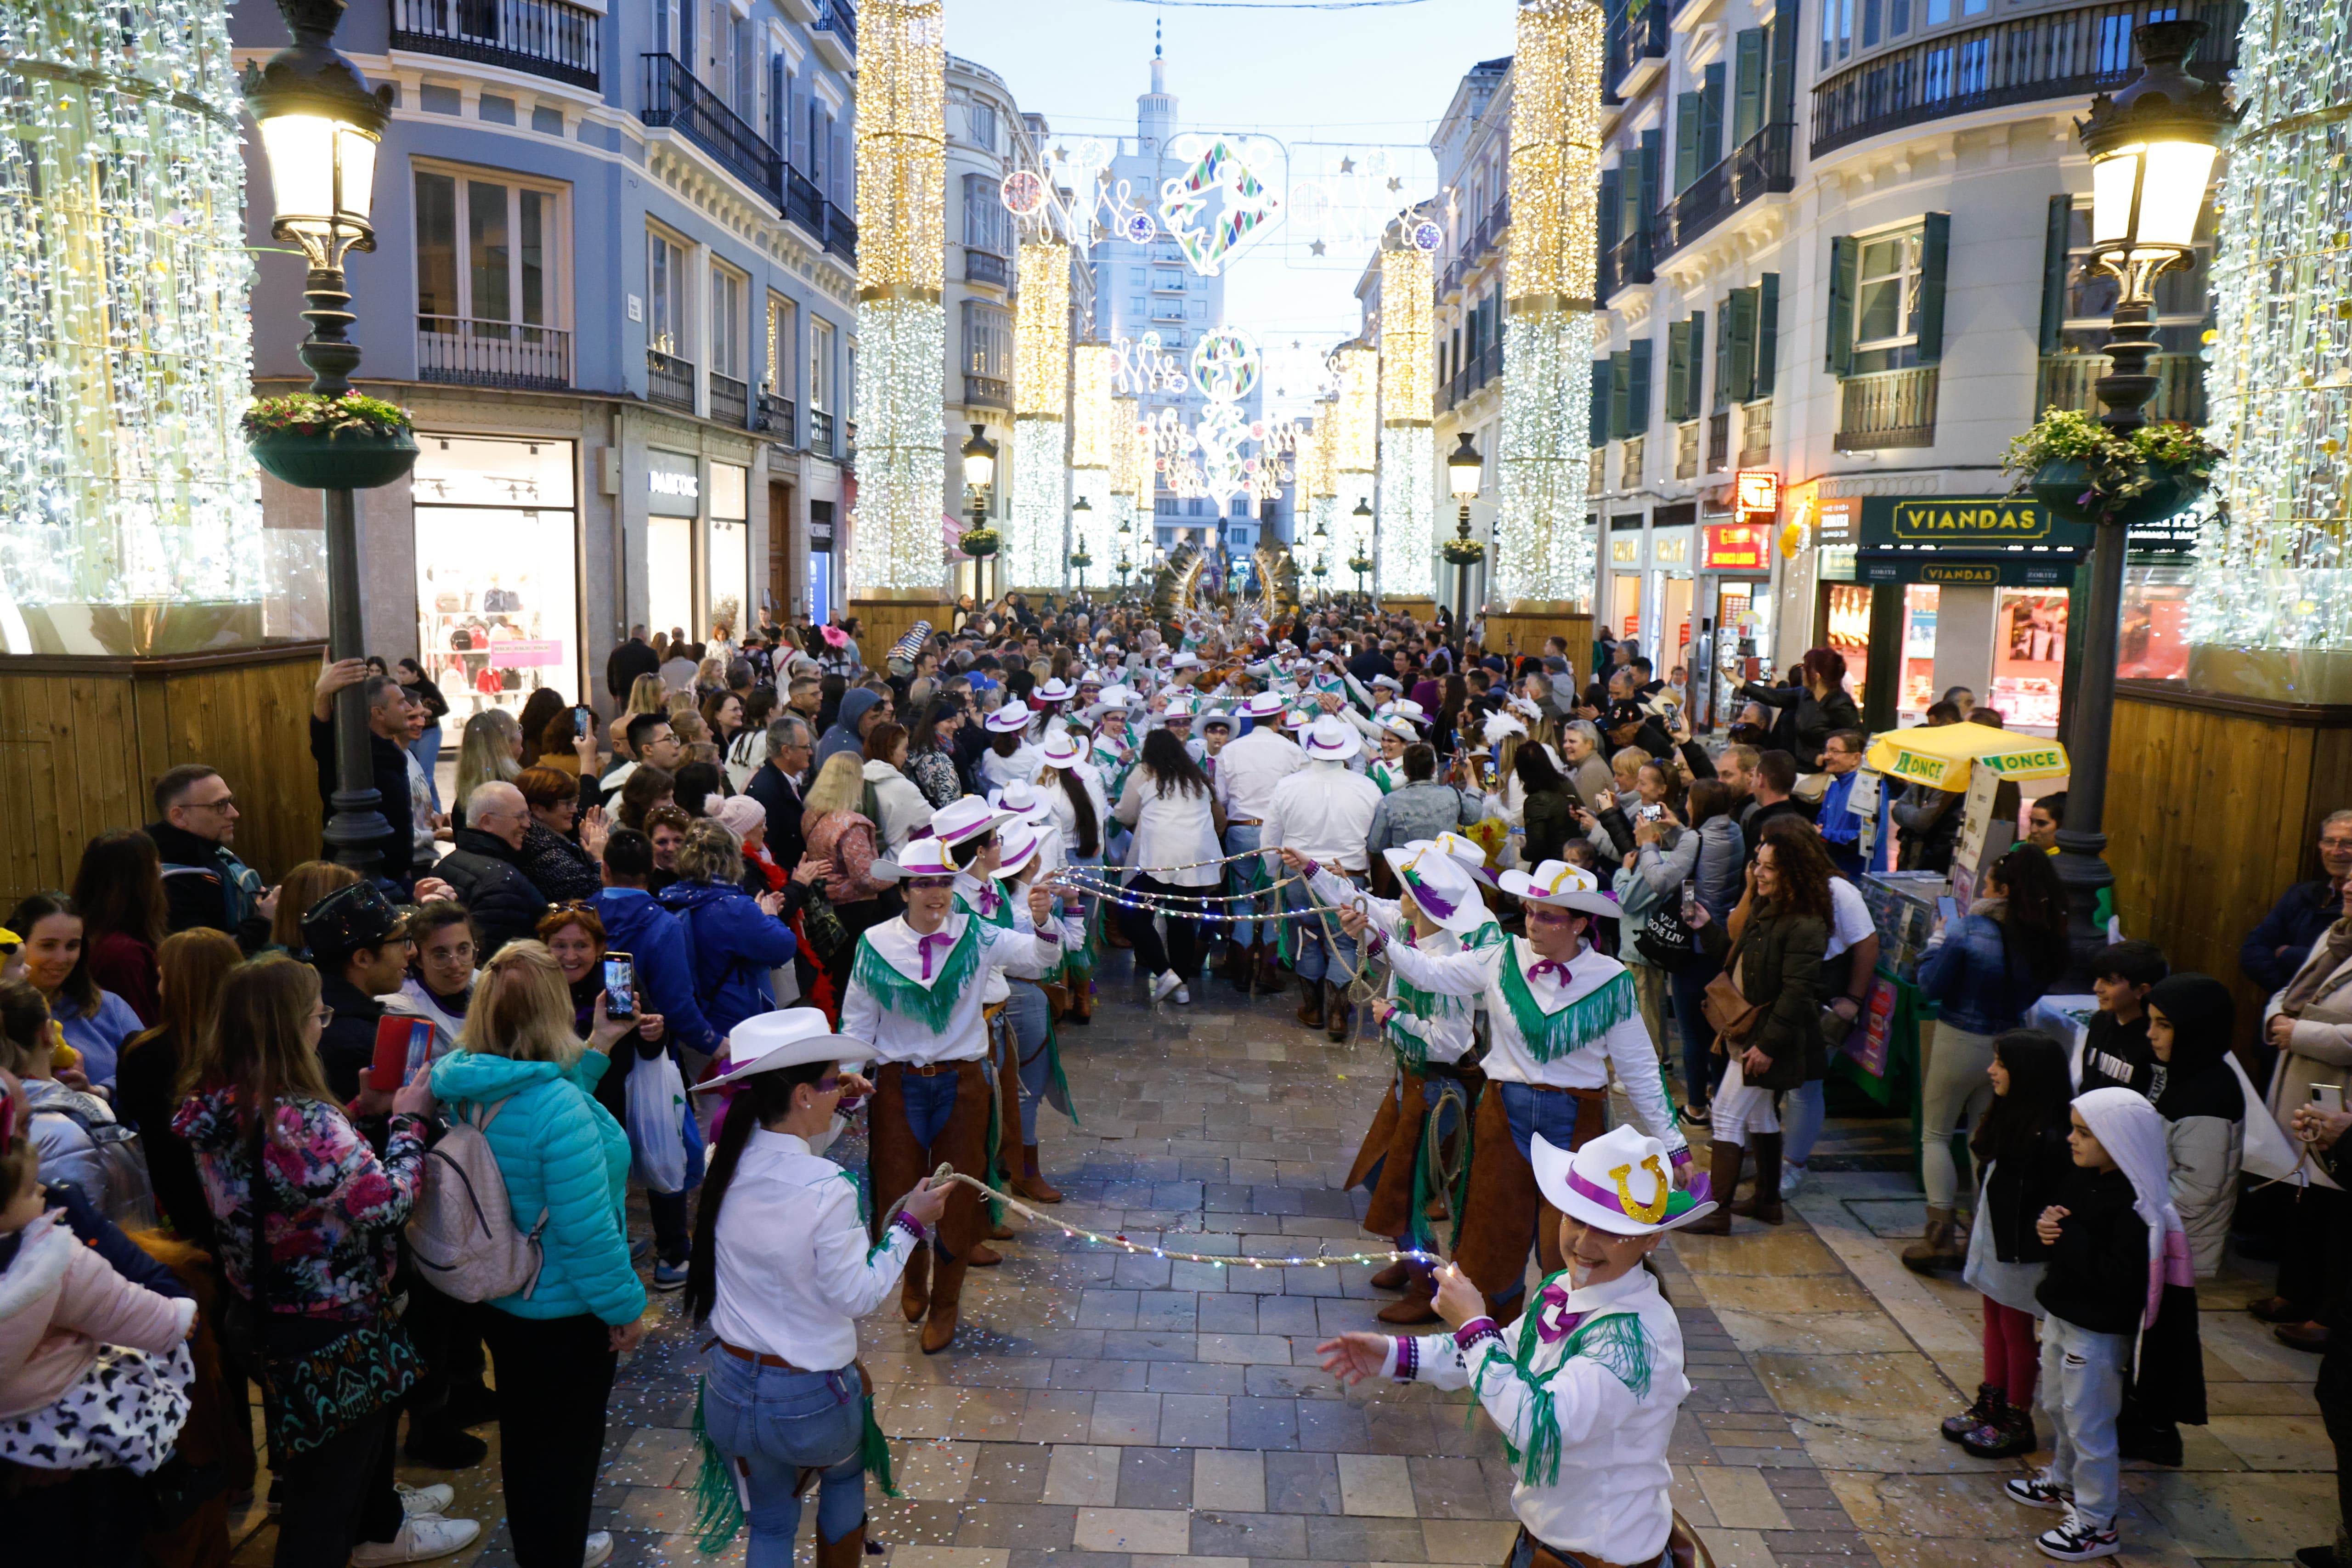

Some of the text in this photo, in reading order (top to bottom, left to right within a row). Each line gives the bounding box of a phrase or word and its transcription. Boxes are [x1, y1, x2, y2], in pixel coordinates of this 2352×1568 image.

[1908, 509, 2035, 529] VIANDAS
[1928, 569, 1992, 580] VIANDAS
[1910, 758, 1945, 780] ONCE
[2006, 752, 2058, 769] ONCE
